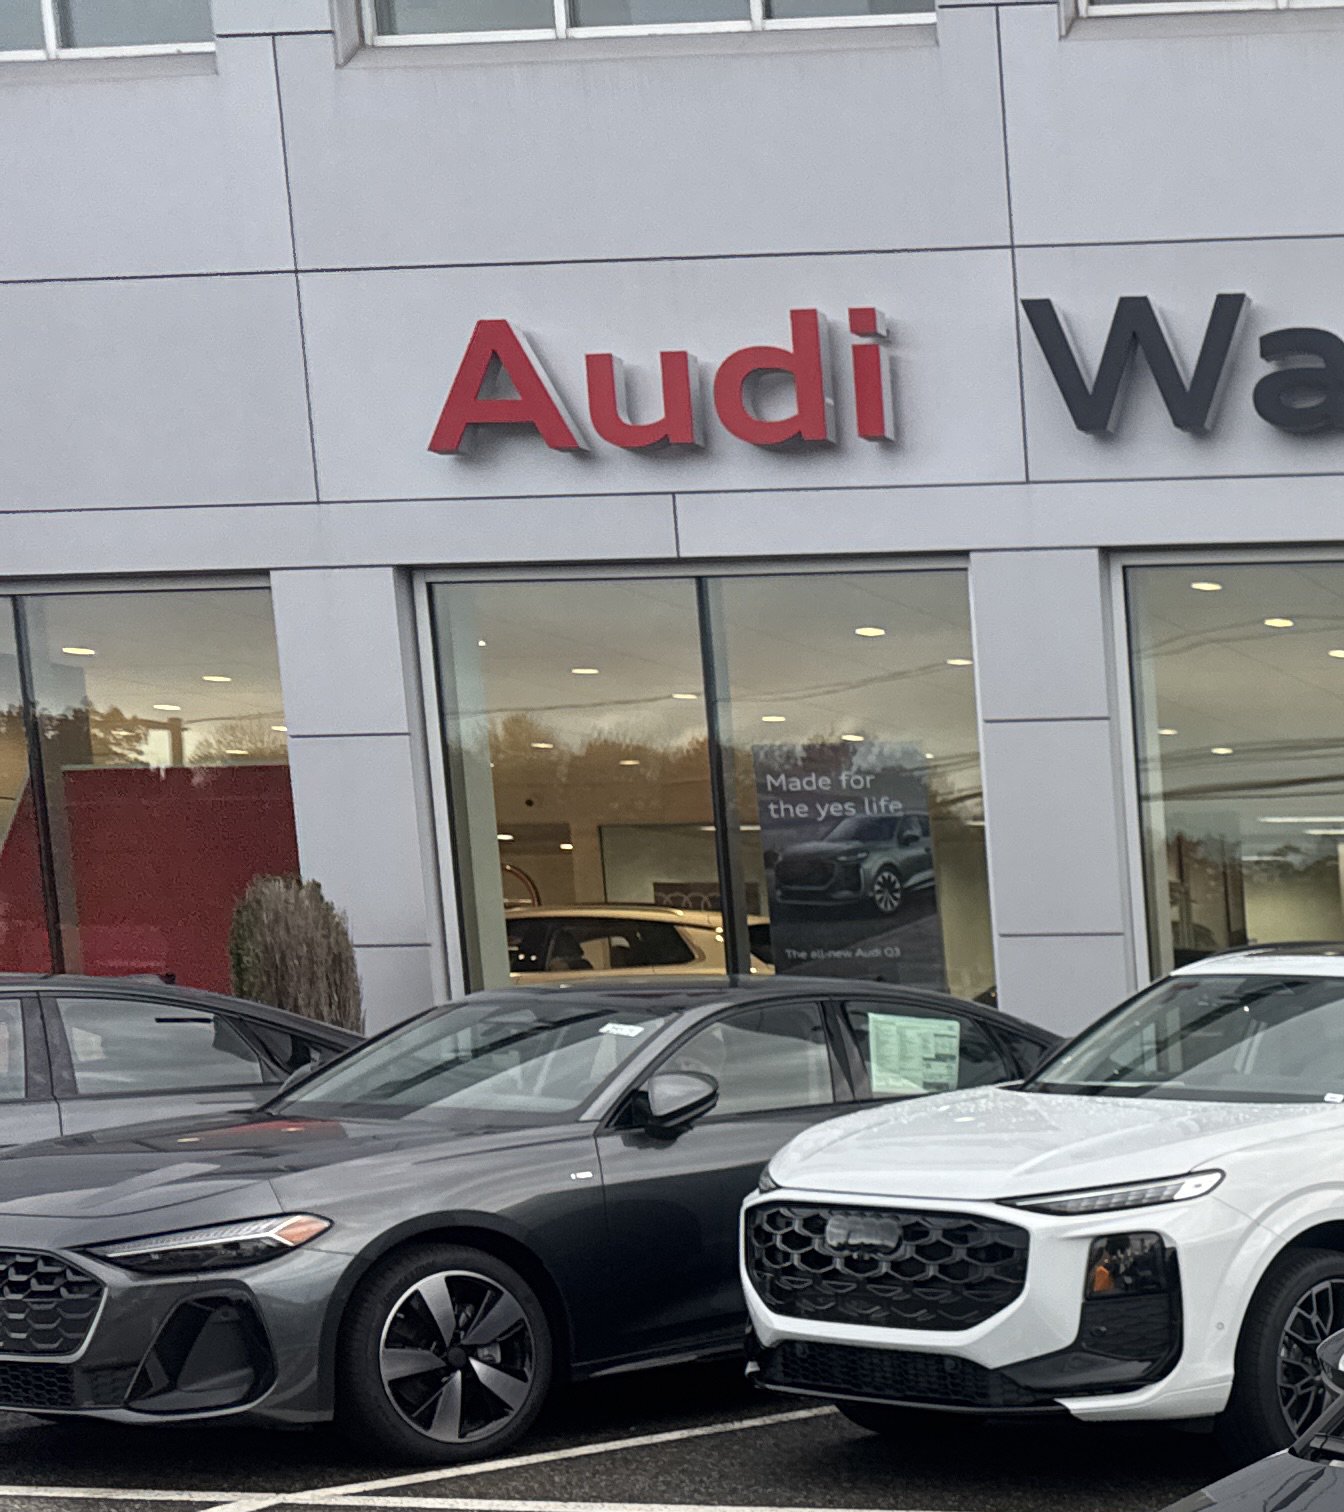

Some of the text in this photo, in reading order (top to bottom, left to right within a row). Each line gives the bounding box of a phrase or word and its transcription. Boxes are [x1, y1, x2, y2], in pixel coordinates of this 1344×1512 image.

[427, 307, 896, 457] Audi
[765, 770, 876, 792] Made for
[768, 799, 809, 819] the
[816, 801, 857, 822] yes
[785, 948, 807, 960] The
[855, 947, 882, 959] Audi
[884, 946, 901, 958] Q3
